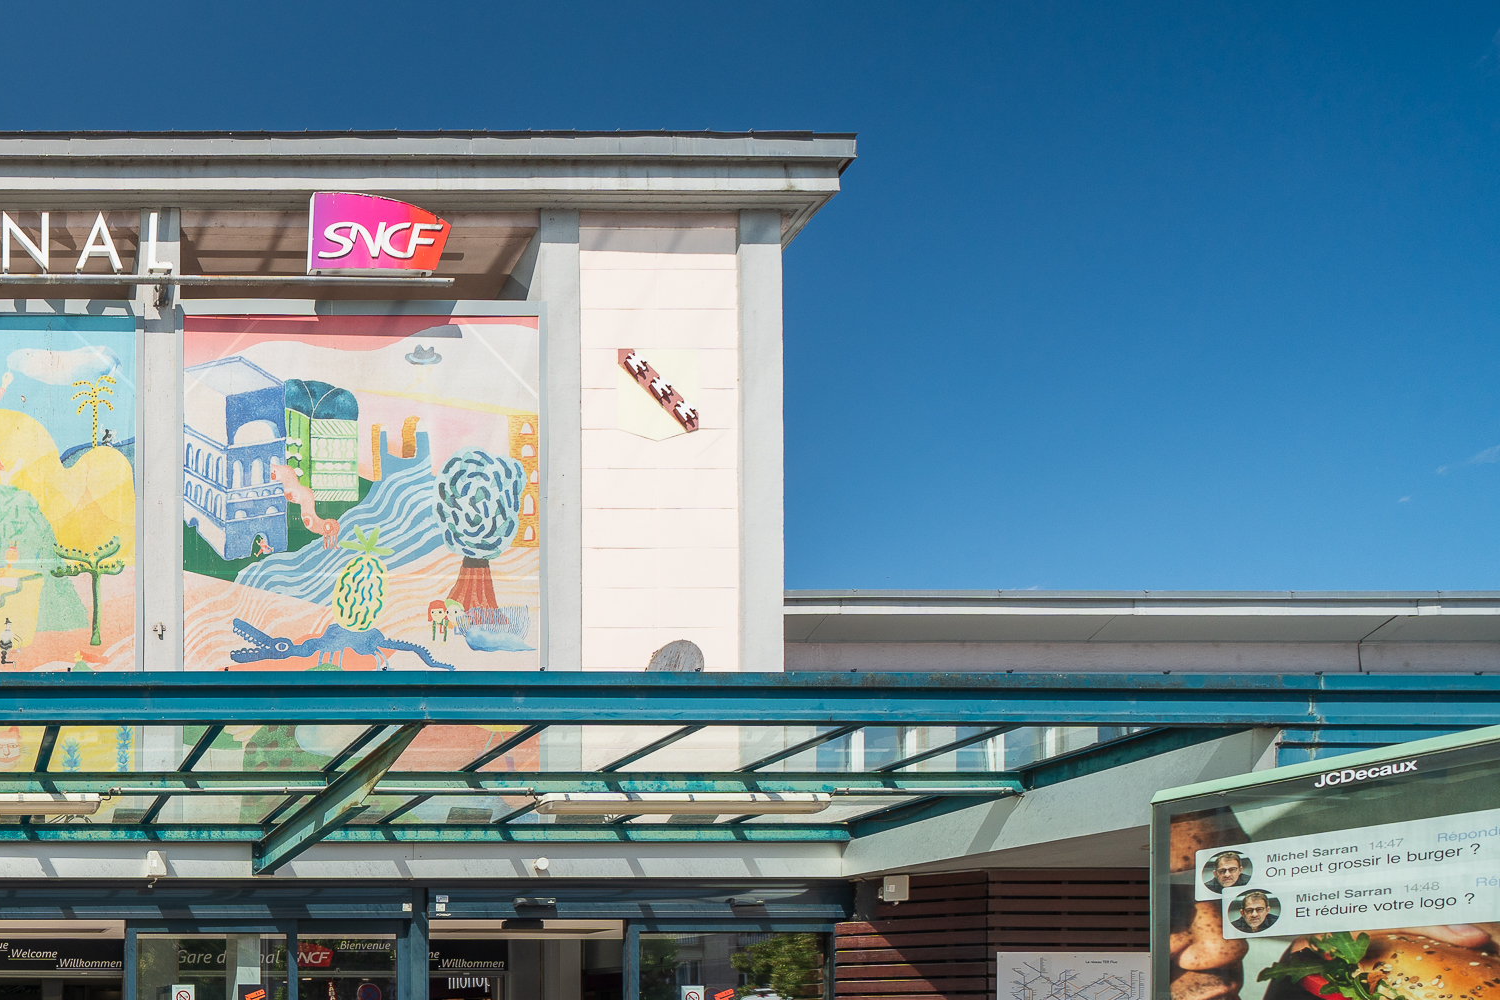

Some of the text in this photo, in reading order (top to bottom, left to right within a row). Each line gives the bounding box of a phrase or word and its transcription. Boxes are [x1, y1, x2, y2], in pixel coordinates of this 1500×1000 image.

[316, 219, 444, 260] SNCF
[1314, 759, 1418, 788] JCDecaux
[1265, 843, 1481, 878] On peut grossir le burger ?
[1266, 838, 1404, 863] Michel Sarran 14:47
[1295, 892, 1475, 918] Et réduire votre logo ?
[1296, 881, 1440, 903] Michel Sarran 14:48
[178, 950, 211, 963] Gare
